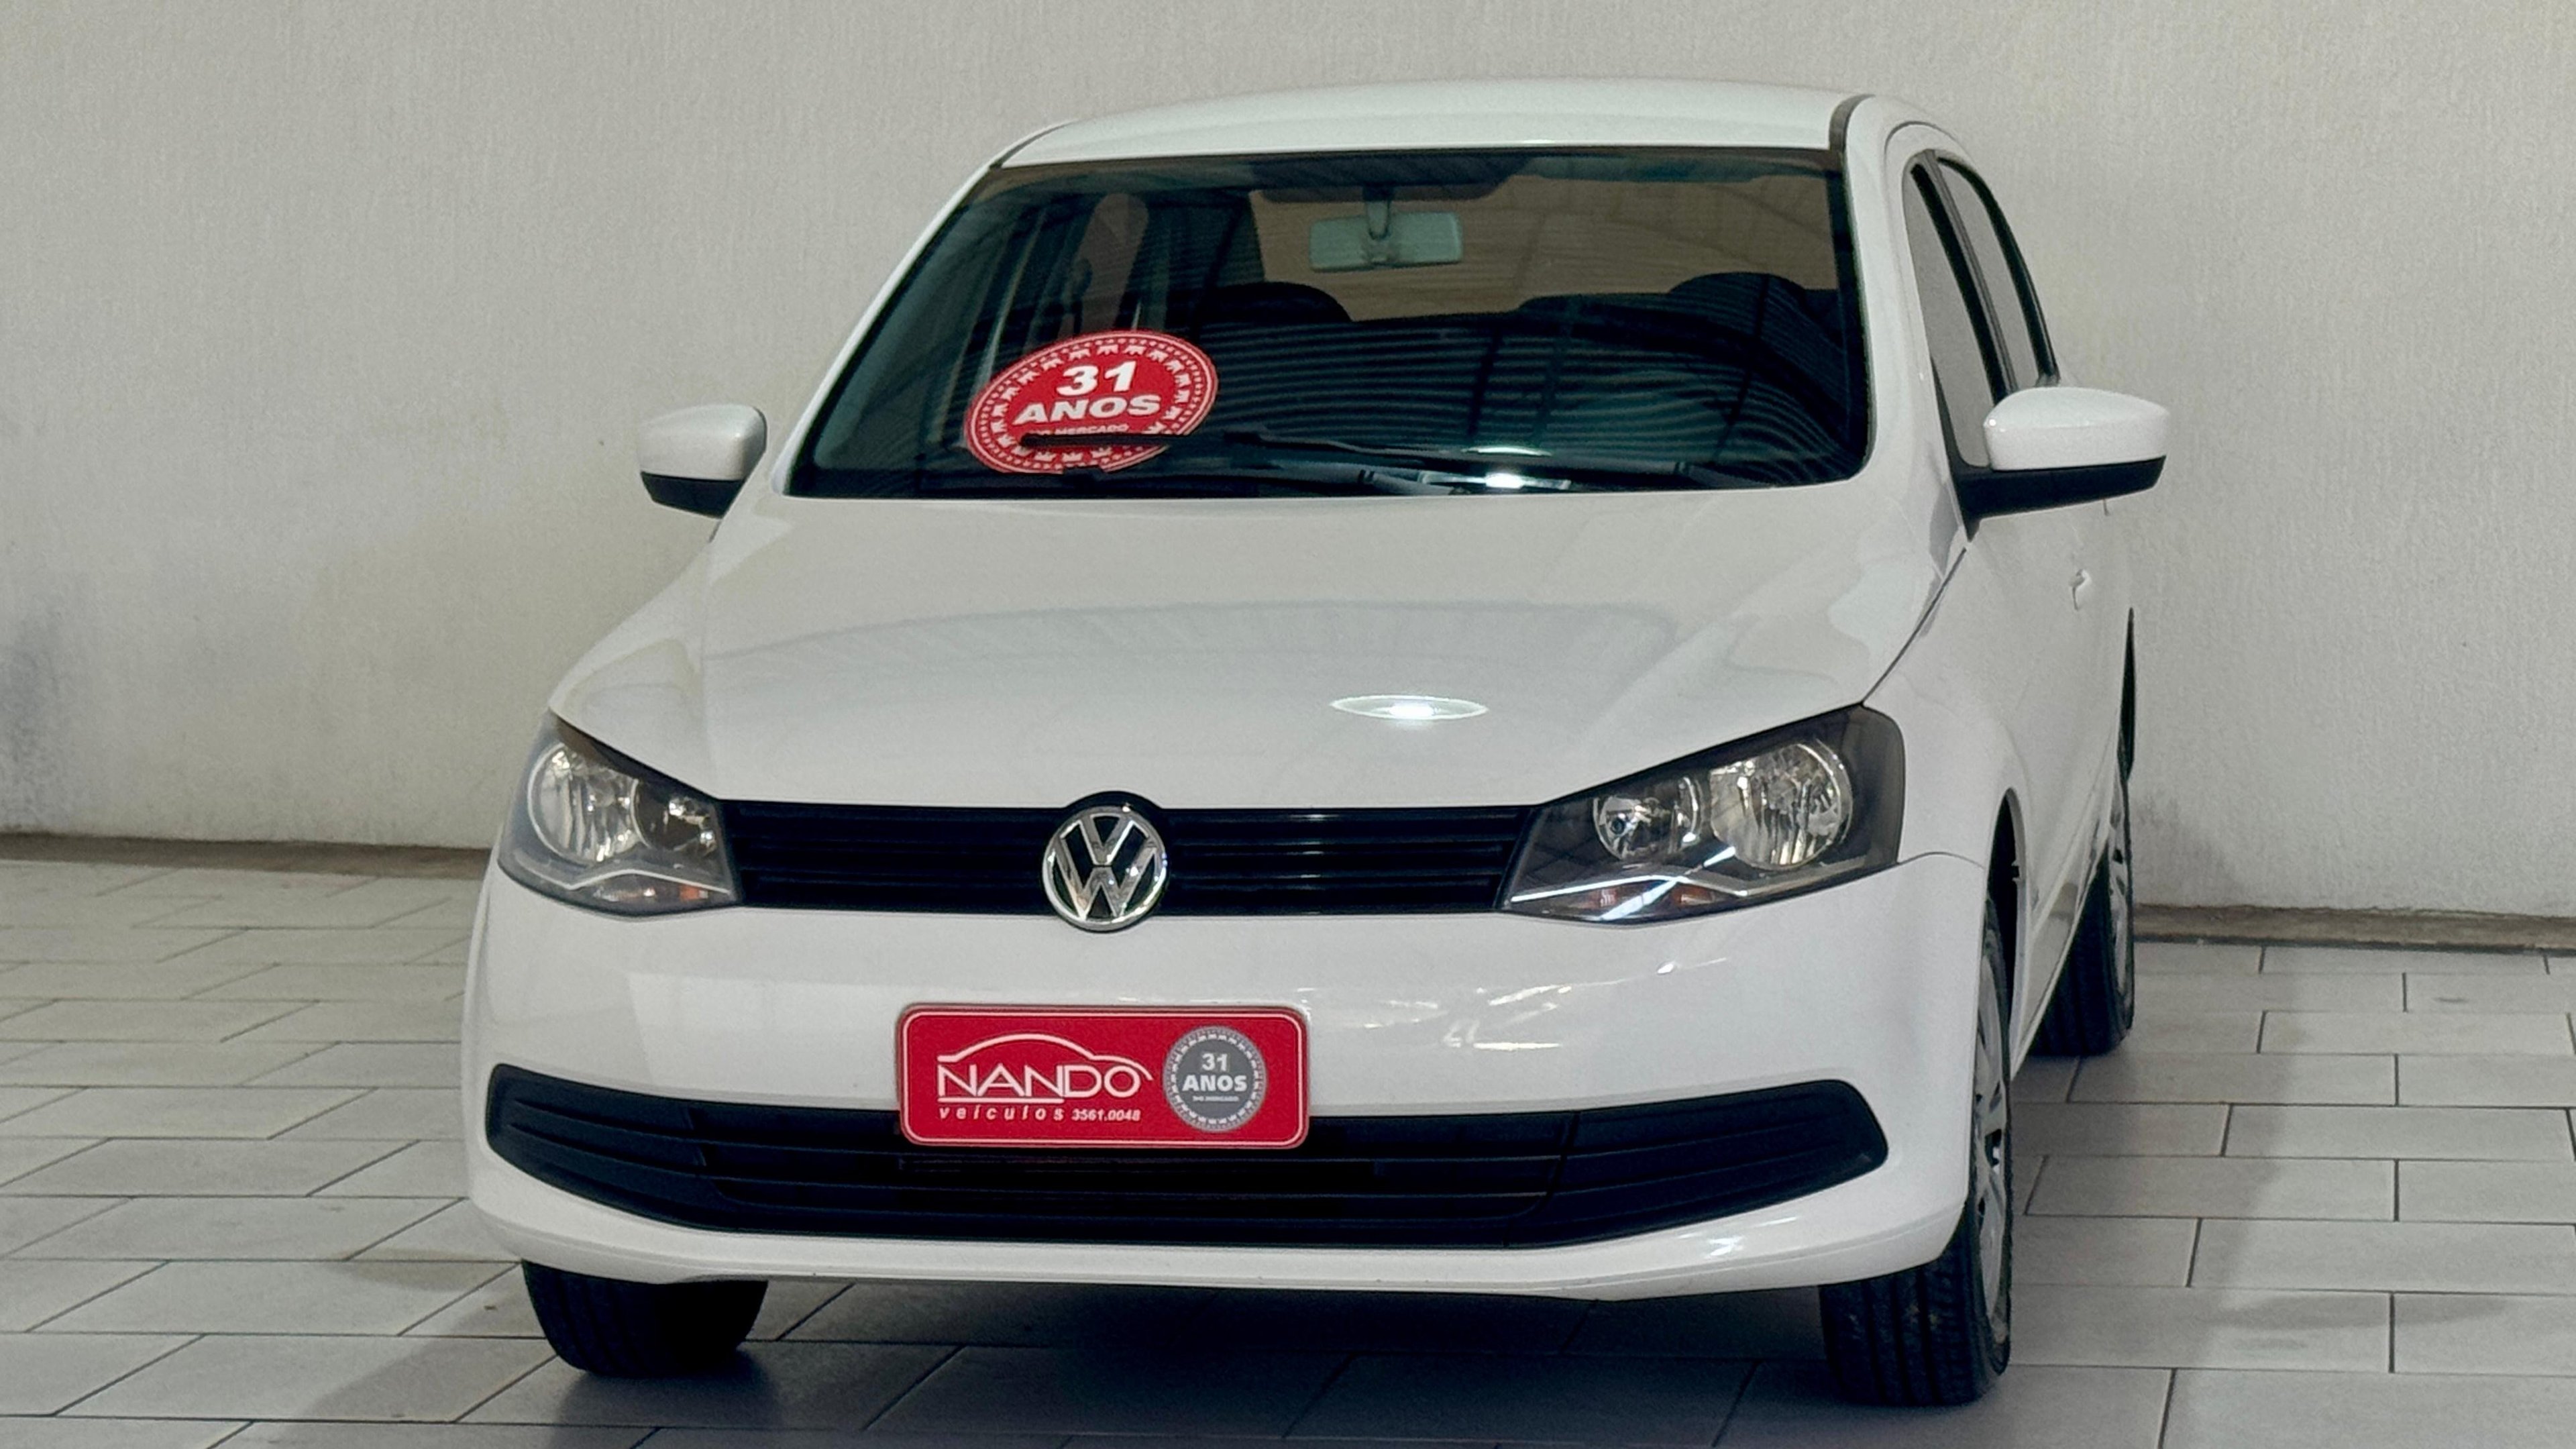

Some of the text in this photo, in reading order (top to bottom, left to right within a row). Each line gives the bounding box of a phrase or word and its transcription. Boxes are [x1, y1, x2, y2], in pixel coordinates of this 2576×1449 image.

[1056, 360, 1137, 396] 31
[1012, 394, 1162, 425] ANOS
[1201, 1053, 1228, 1071] 31
[937, 1063, 1141, 1099] NANDO
[1181, 1075, 1248, 1092] ANOS
